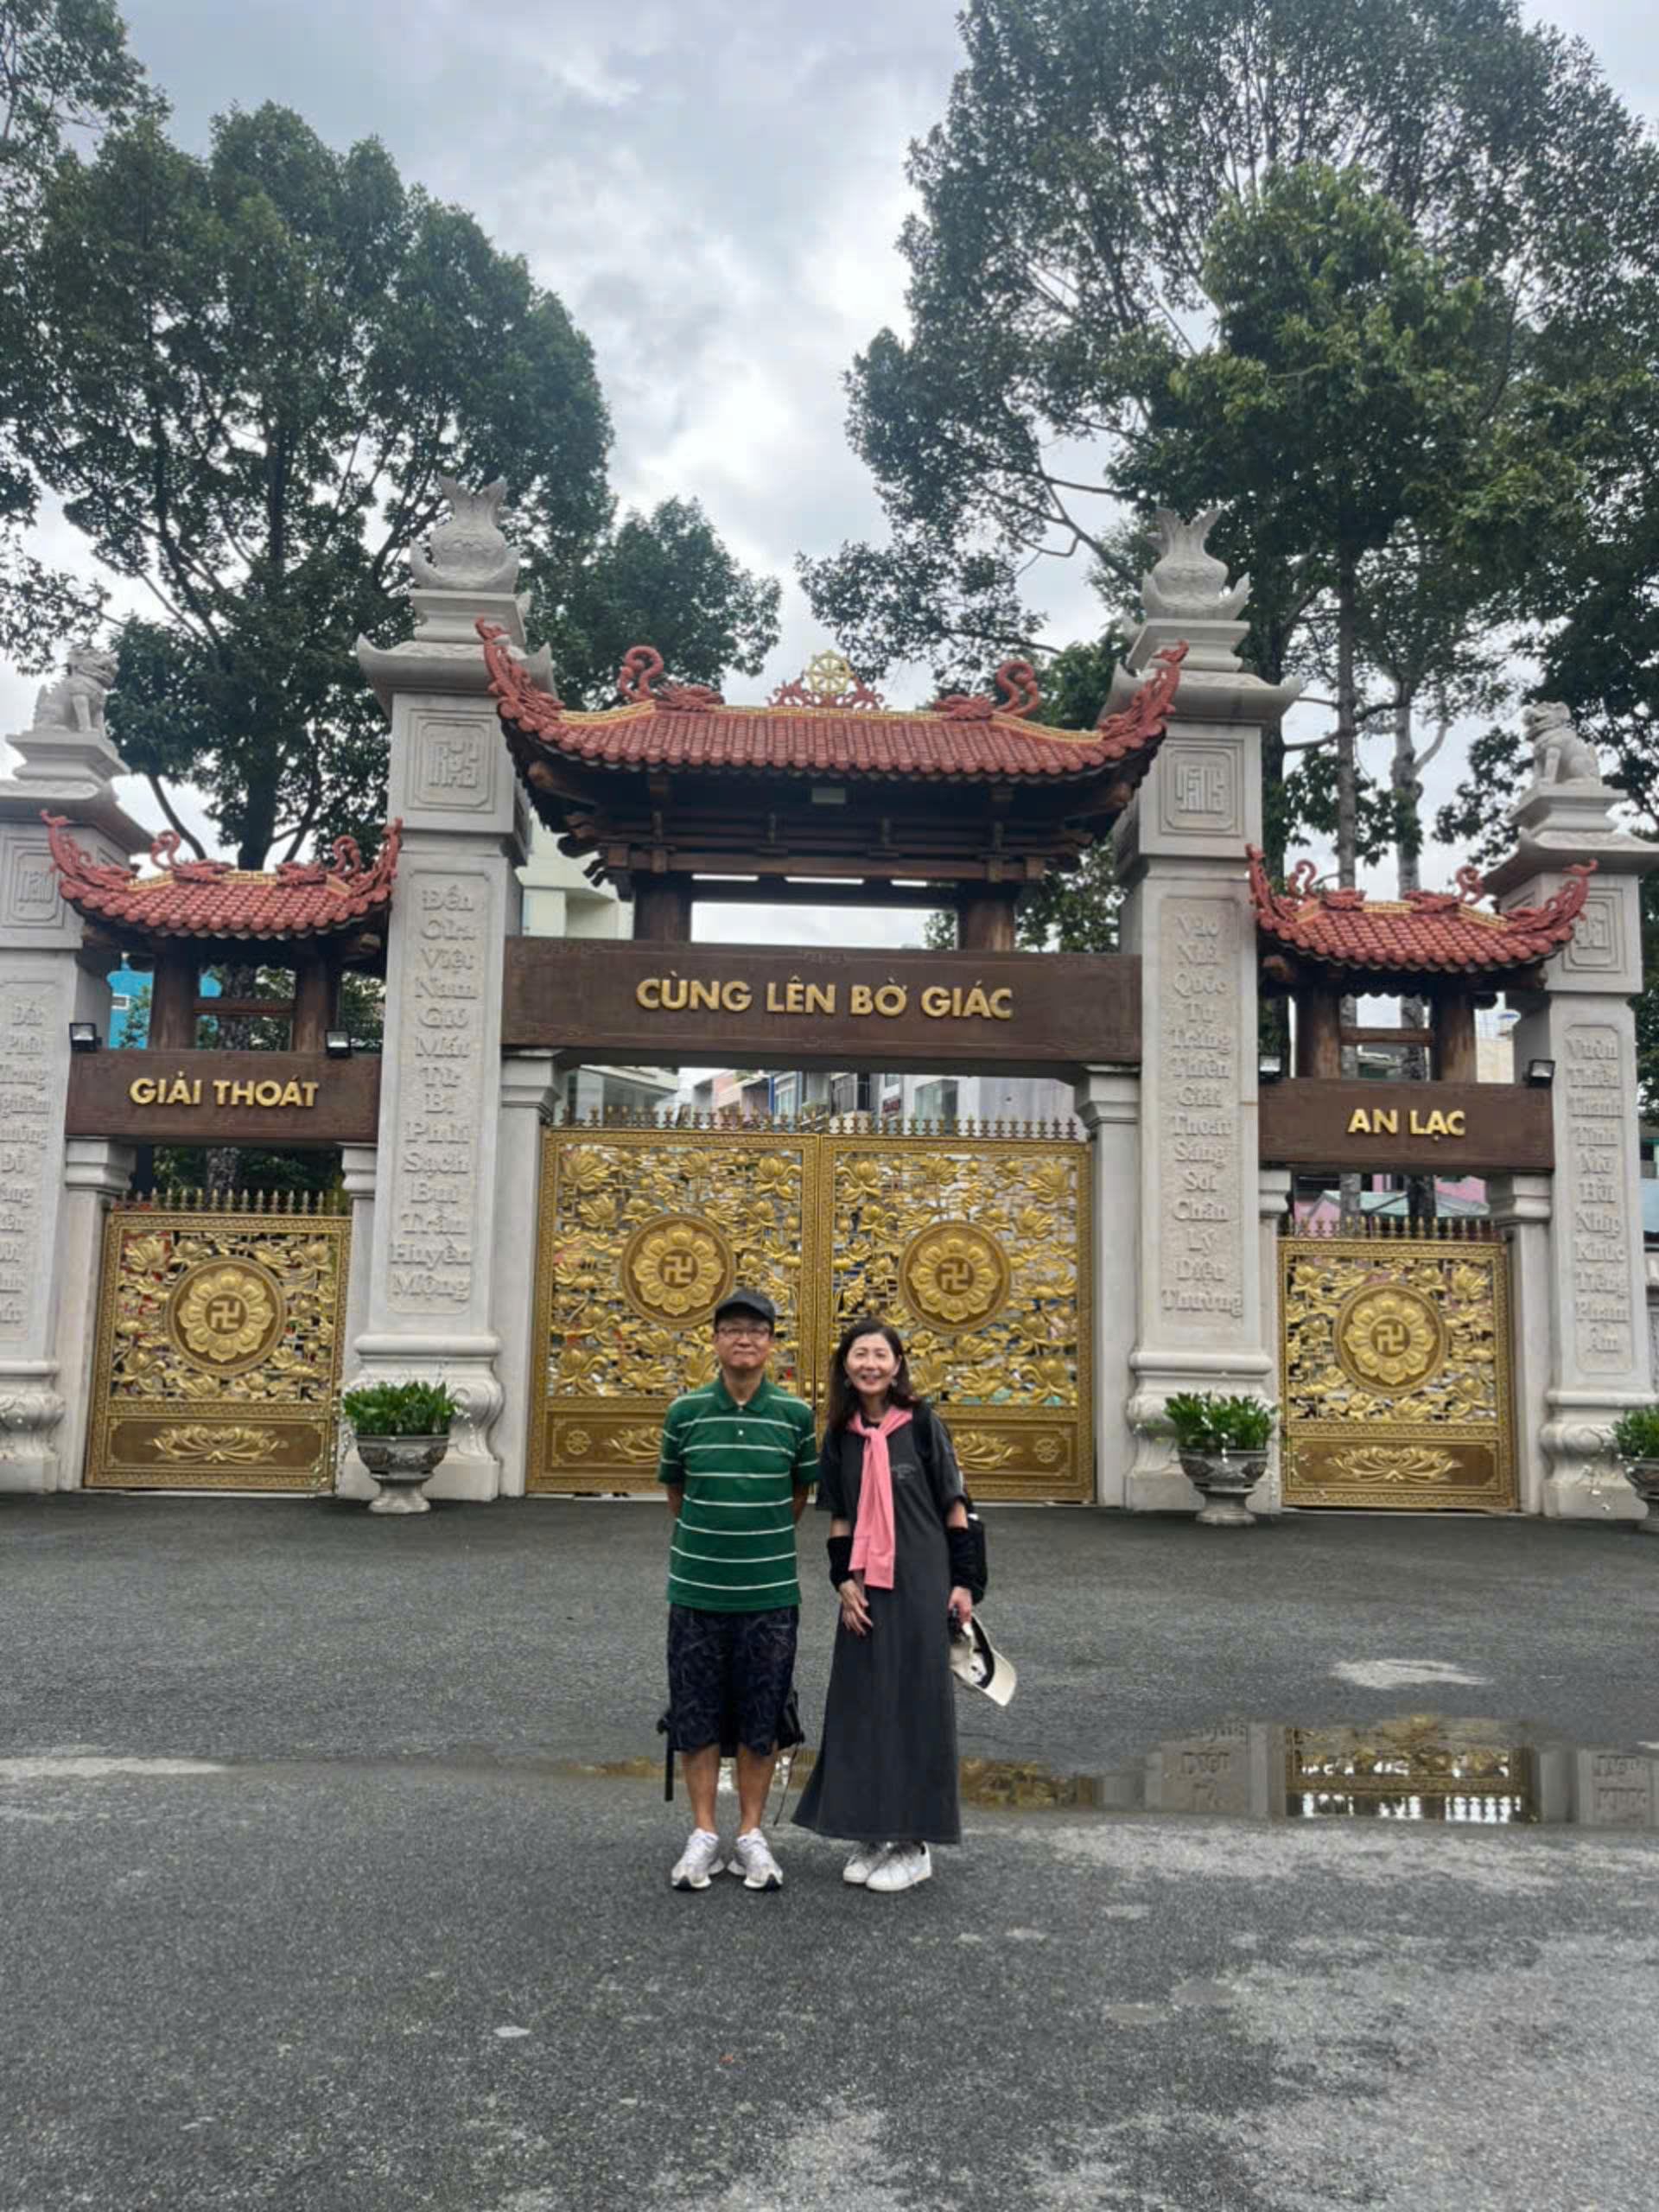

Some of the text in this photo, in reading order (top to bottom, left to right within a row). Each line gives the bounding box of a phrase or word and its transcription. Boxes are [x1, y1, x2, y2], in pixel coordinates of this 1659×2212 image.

[420, 948, 474, 975] Việt
[415, 977, 478, 1000] Nam
[636, 970, 1014, 1020] CÙNG LÊN BỜ GIÁC
[130, 1071, 319, 1107] GIẢI THOÁT
[1347, 1109, 1466, 1141] AN LẠC
[1172, 1199, 1230, 1222] Chân
